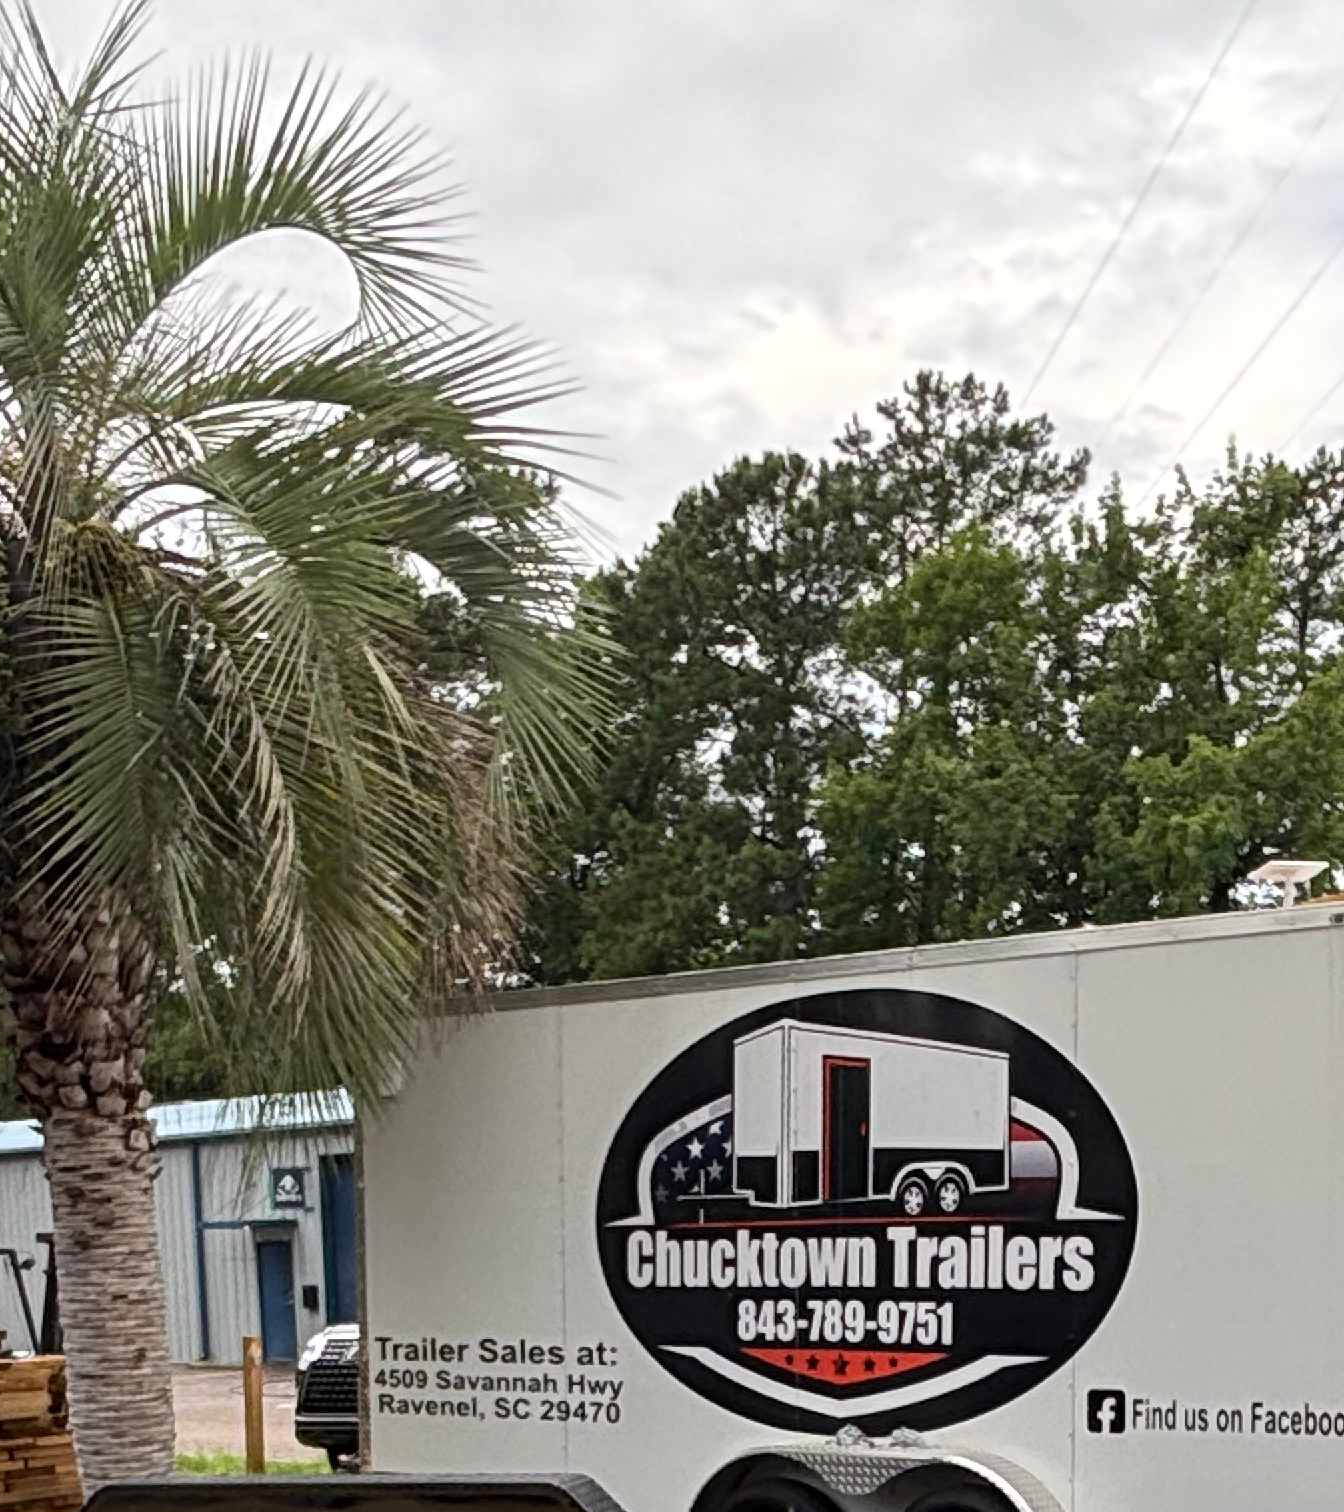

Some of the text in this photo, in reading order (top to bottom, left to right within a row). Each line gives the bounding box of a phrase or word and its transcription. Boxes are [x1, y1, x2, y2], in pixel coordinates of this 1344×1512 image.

[626, 1225, 1095, 1292] Chucktown Trailers
[737, 1299, 954, 1346] 843-789-9751
[374, 1336, 618, 1366] Trailer Sales at:
[374, 1368, 624, 1401] 4509 Savannah Hwy
[378, 1394, 621, 1424] Ravenel, SC 29470
[1132, 1398, 1177, 1431] Find
[1184, 1407, 1209, 1432] us
[1216, 1408, 1244, 1433] on
